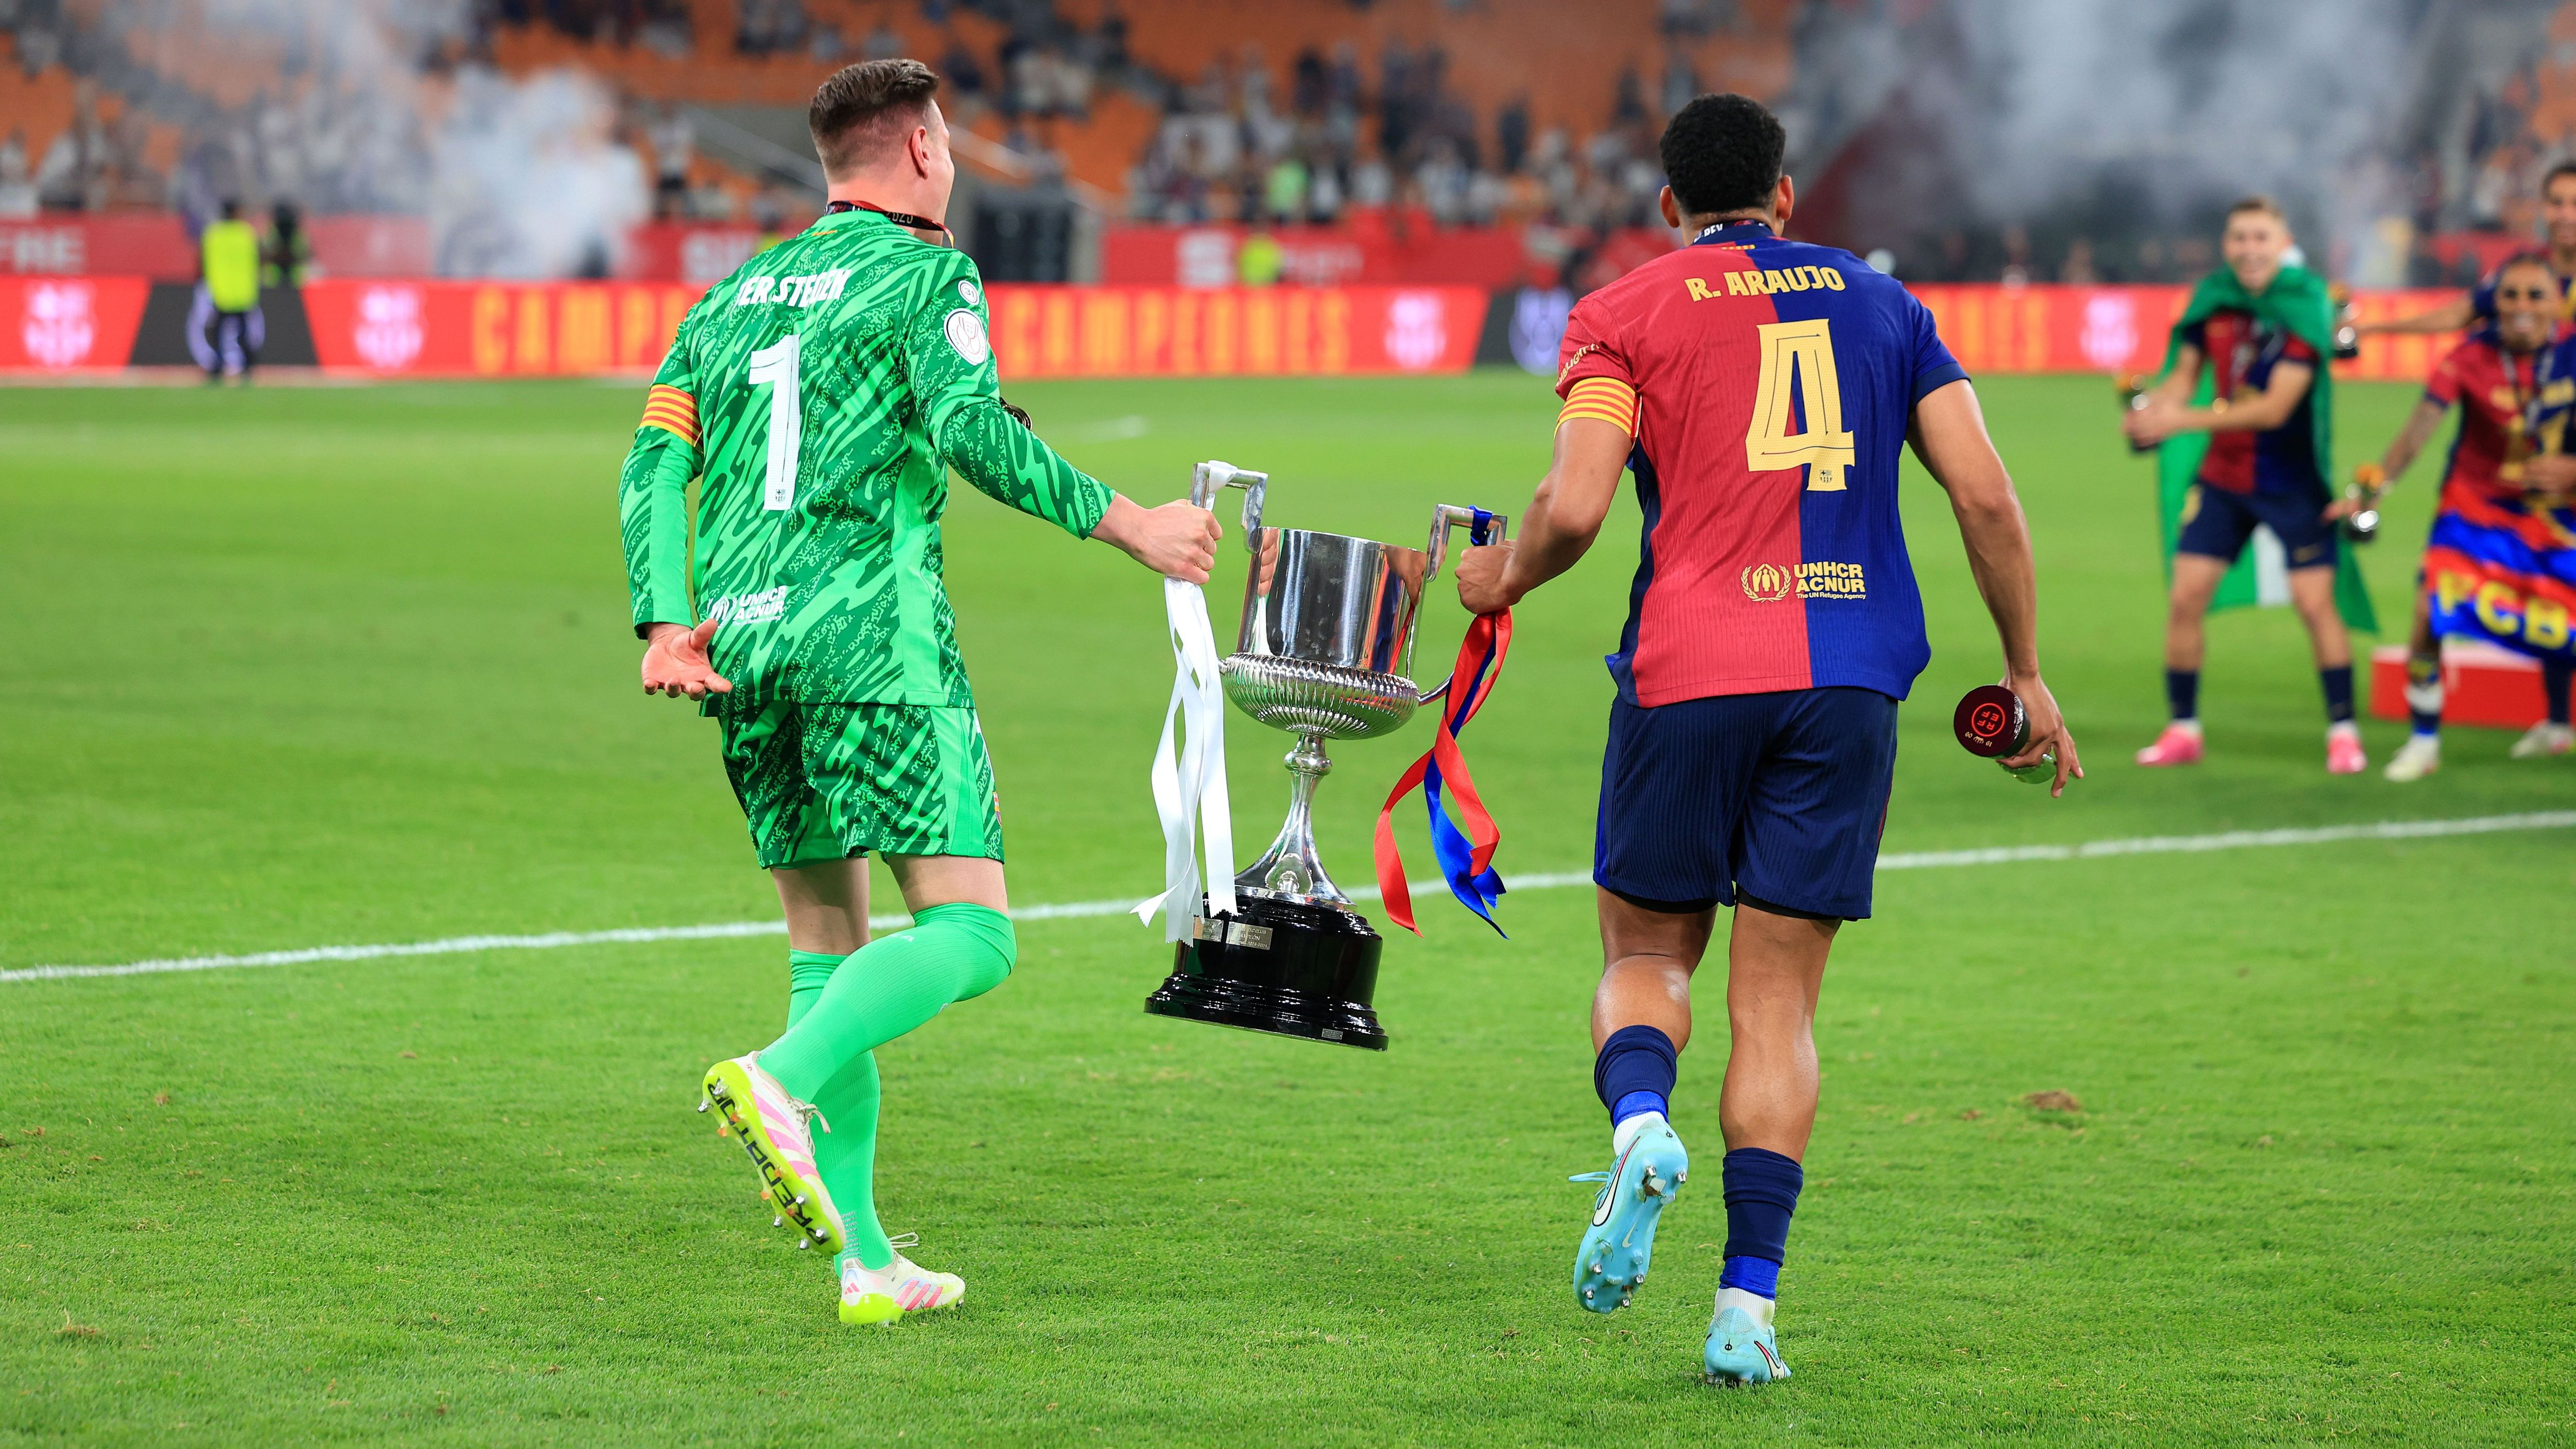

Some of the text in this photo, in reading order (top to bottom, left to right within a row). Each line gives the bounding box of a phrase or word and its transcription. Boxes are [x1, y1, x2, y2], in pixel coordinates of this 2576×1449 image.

[964, 287, 974, 298] 31
[1684, 266, 1846, 302] R. ARAUJO
[1745, 318, 1855, 492] 4
[747, 334, 800, 511] 1
[1793, 561, 1864, 578] UNHCR
[739, 585, 787, 607] UNHCR
[1795, 577, 1866, 593] ACNUR
[733, 600, 785, 621] ACNUR
[2438, 569, 2568, 650] FCB
[707, 1076, 831, 1246] PREDATOR
